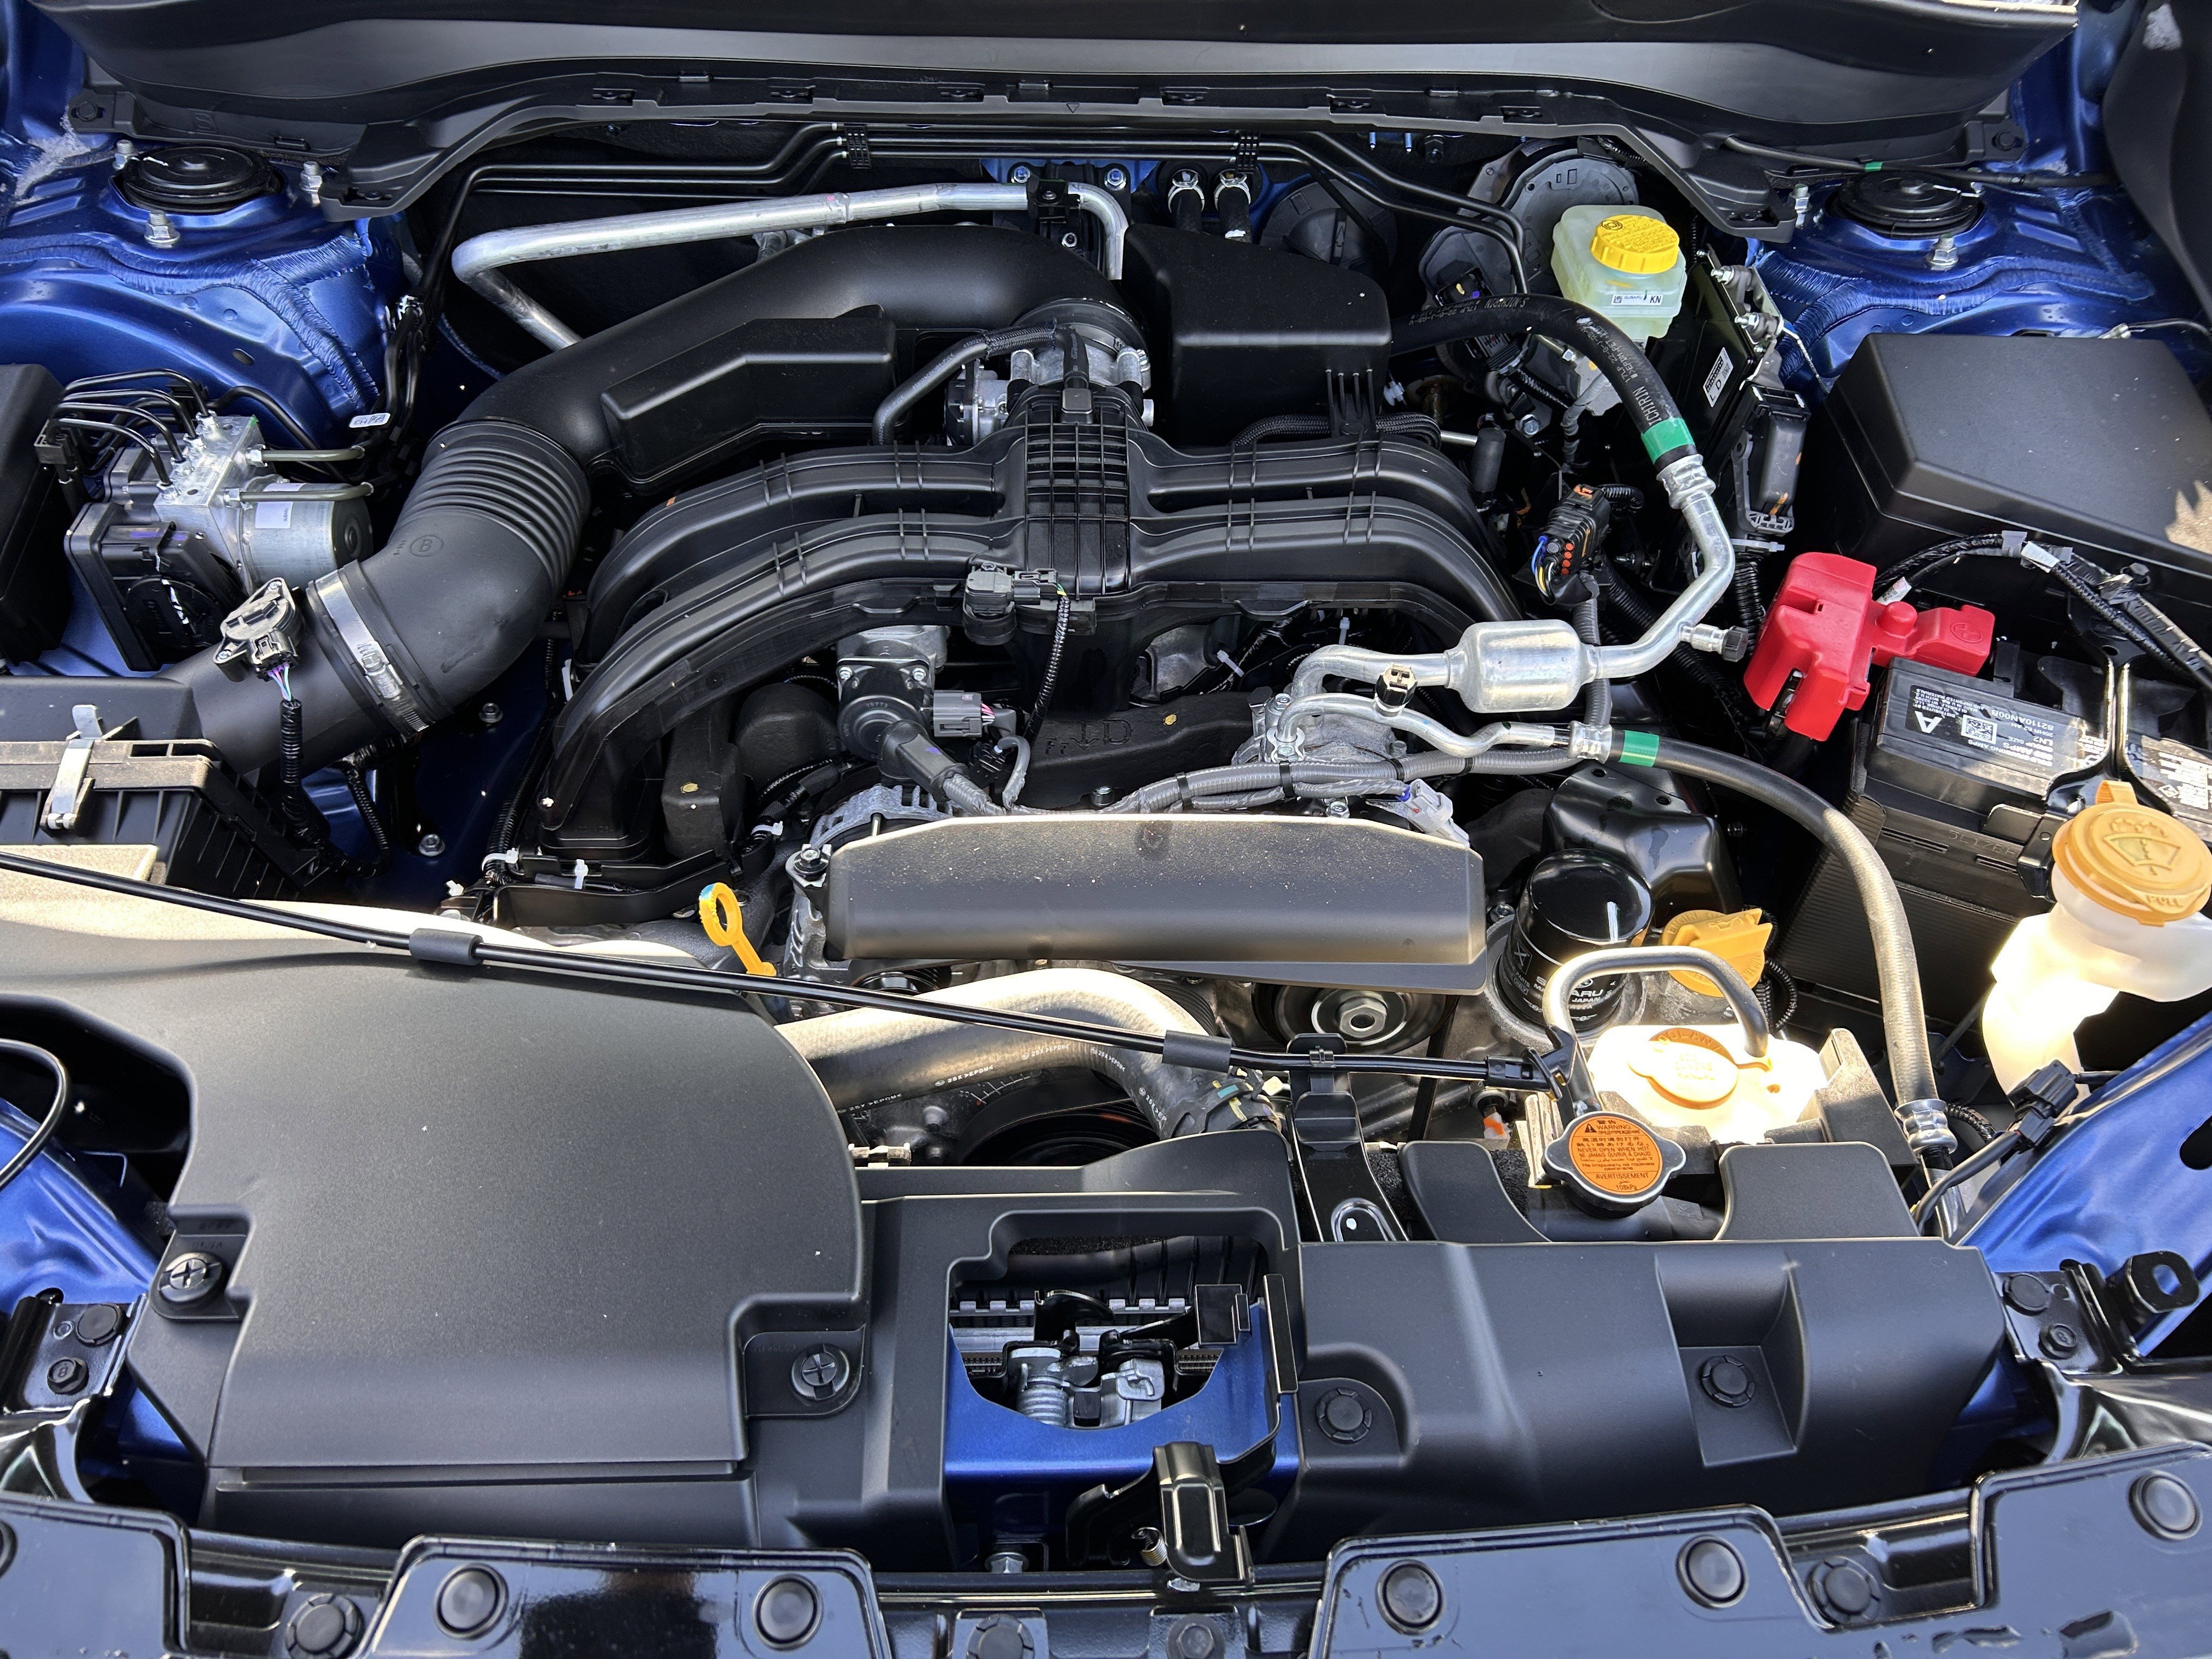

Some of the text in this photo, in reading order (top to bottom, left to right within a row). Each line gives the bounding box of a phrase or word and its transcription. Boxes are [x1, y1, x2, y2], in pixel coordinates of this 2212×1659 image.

[1650, 295, 1661, 303] KN
[1716, 379, 1722, 391] D
[1915, 710, 1943, 733] A
[1990, 709, 2054, 731] 82110AN00B
[1967, 738, 1989, 748] AMPS
[2032, 735, 2054, 746] LN2
[2001, 741, 2033, 755] AMPS
